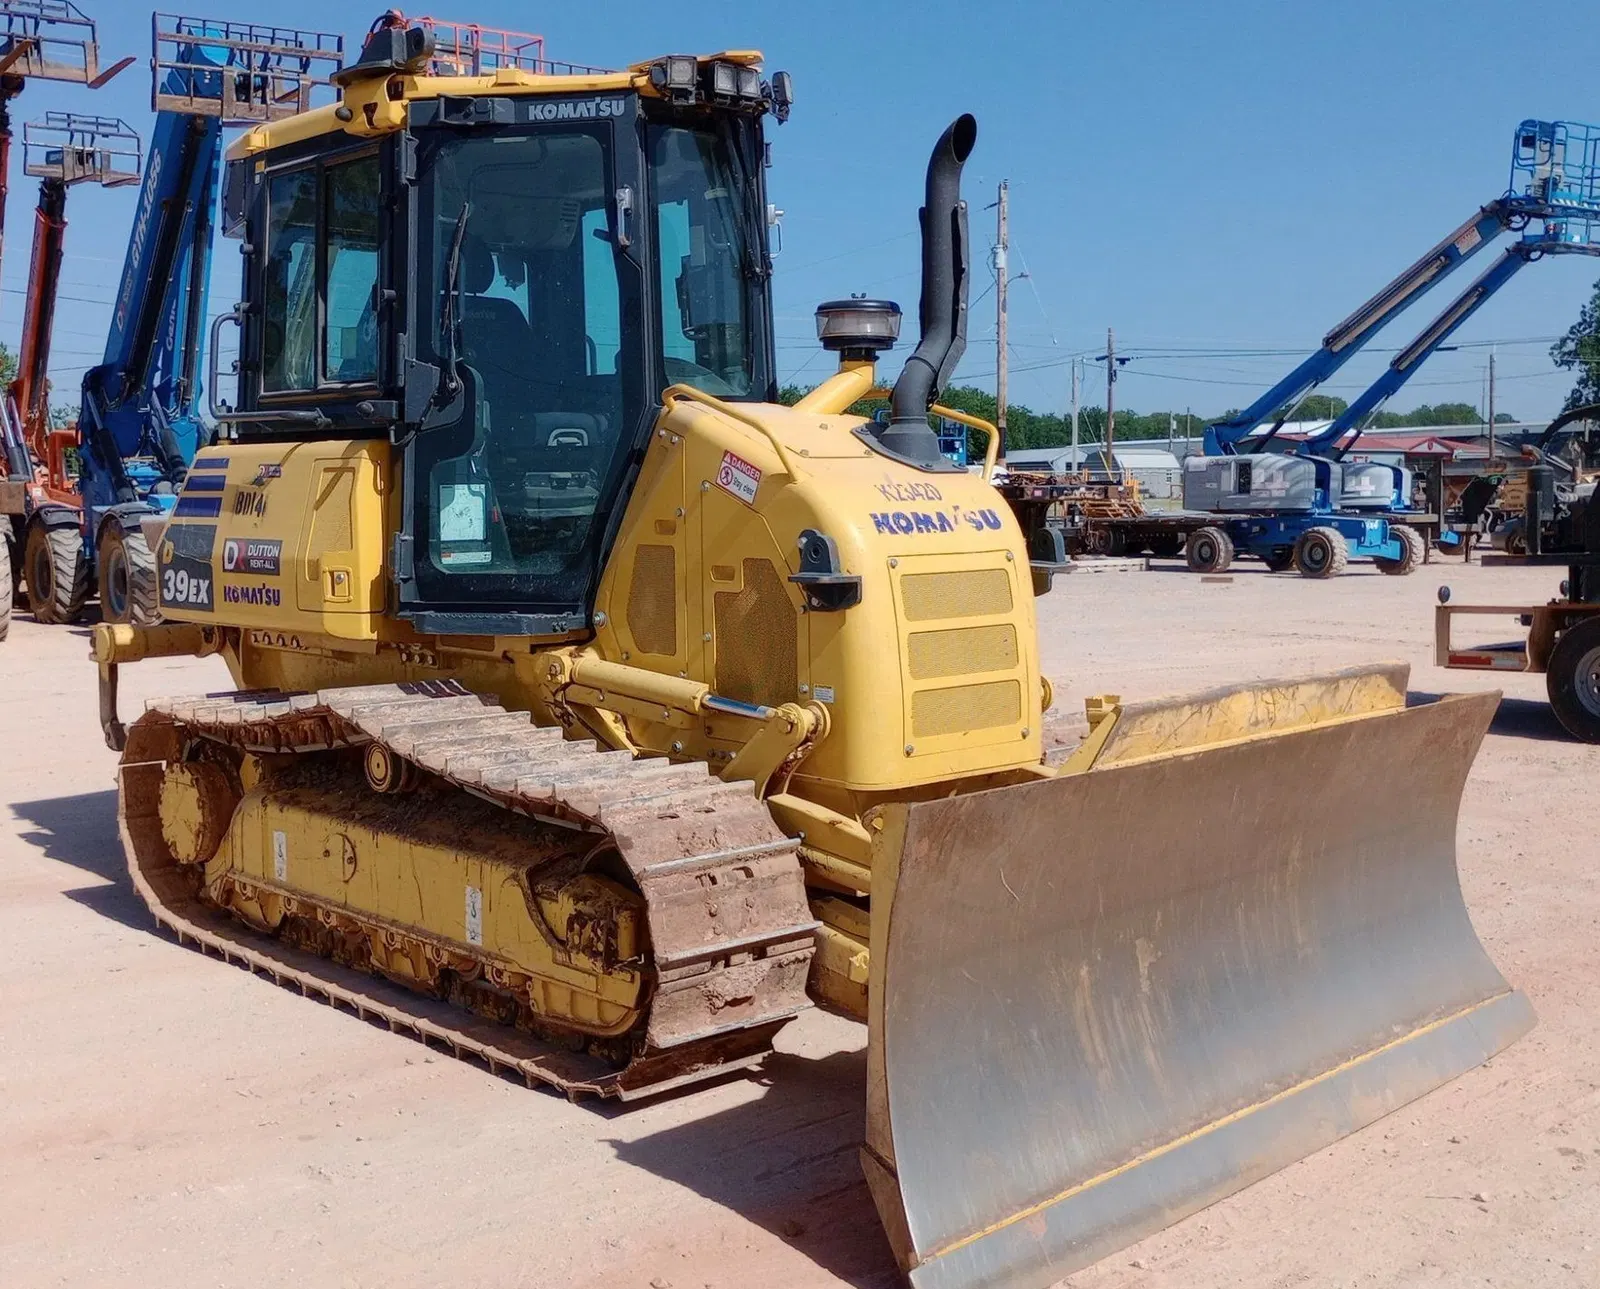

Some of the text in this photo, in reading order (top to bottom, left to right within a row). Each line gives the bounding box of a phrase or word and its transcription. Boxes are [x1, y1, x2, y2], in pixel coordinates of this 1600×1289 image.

[528, 96, 625, 120] KOMATSU
[131, 148, 162, 268] GTH-1056
[731, 456, 761, 482] DANGER
[247, 544, 280, 558] DUTTON
[249, 558, 276, 570] RENT-ALL
[163, 569, 210, 605] 39EX
[223, 583, 281, 607] KOMATSU
